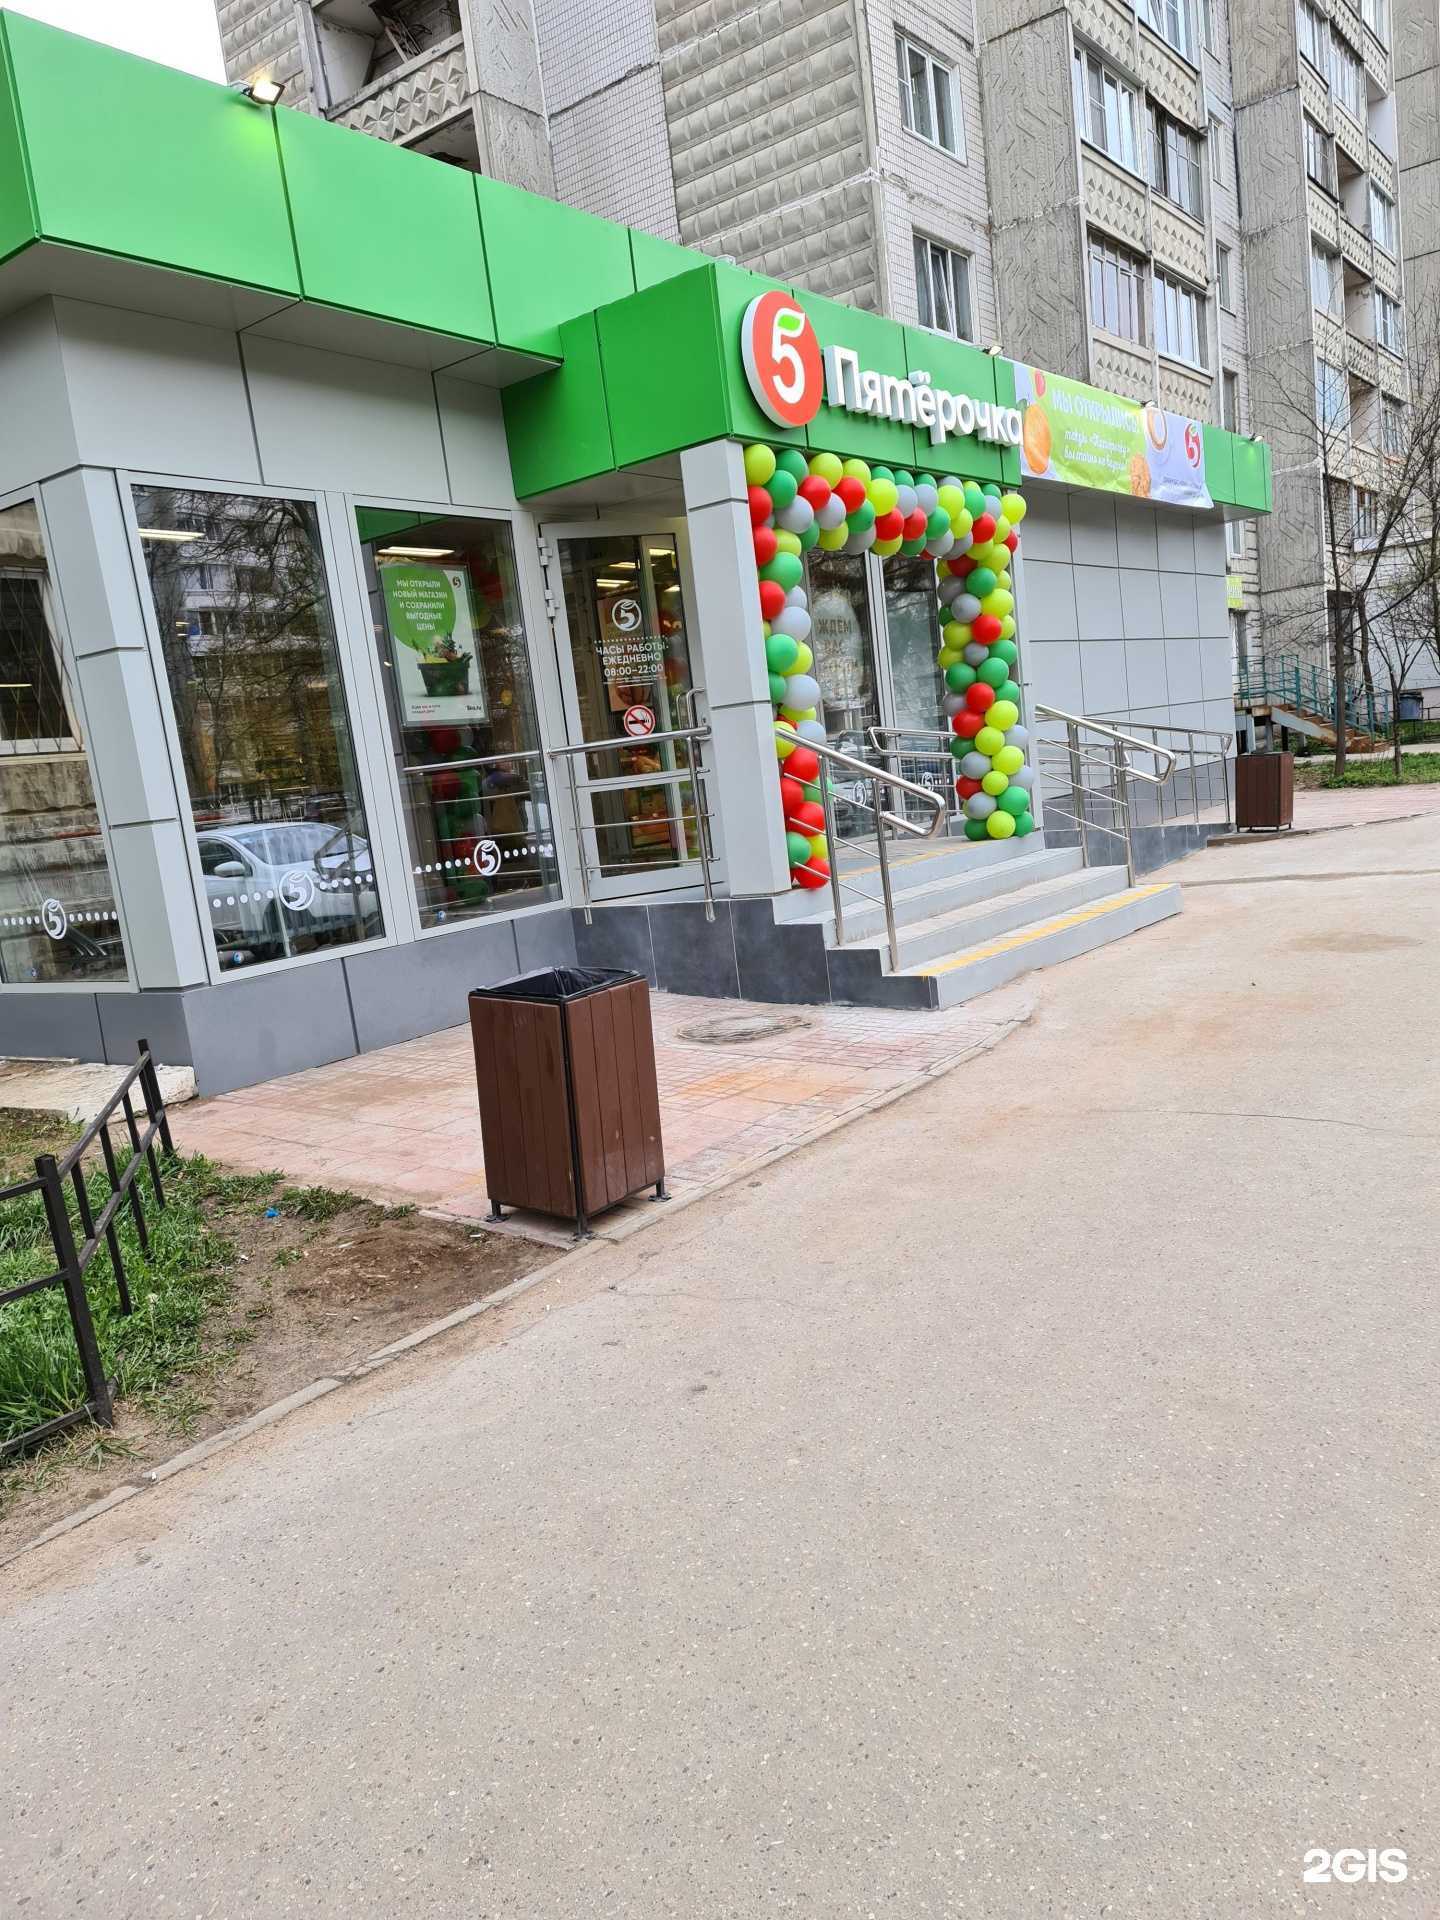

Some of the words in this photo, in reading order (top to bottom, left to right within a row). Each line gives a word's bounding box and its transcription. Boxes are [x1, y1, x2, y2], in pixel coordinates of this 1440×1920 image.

[771, 306, 806, 404] 5
[823, 344, 1023, 446] Пятёрочка
[396, 579, 408, 587] МЫ
[409, 580, 441, 588] ОТКРЫЛИ
[392, 589, 417, 598] НОВЫЙ
[418, 591, 448, 599] МАГАЗИН
[400, 601, 405, 609] И
[406, 601, 445, 609] СОХРАНИЛИ
[406, 612, 442, 620] ВЫГОДНЫЕ
[416, 622, 436, 631] ЦЕНЫ
[596, 645, 625, 655] ЧАСЫ
[602, 653, 662, 665] ЕЖЕДНЕВНО
